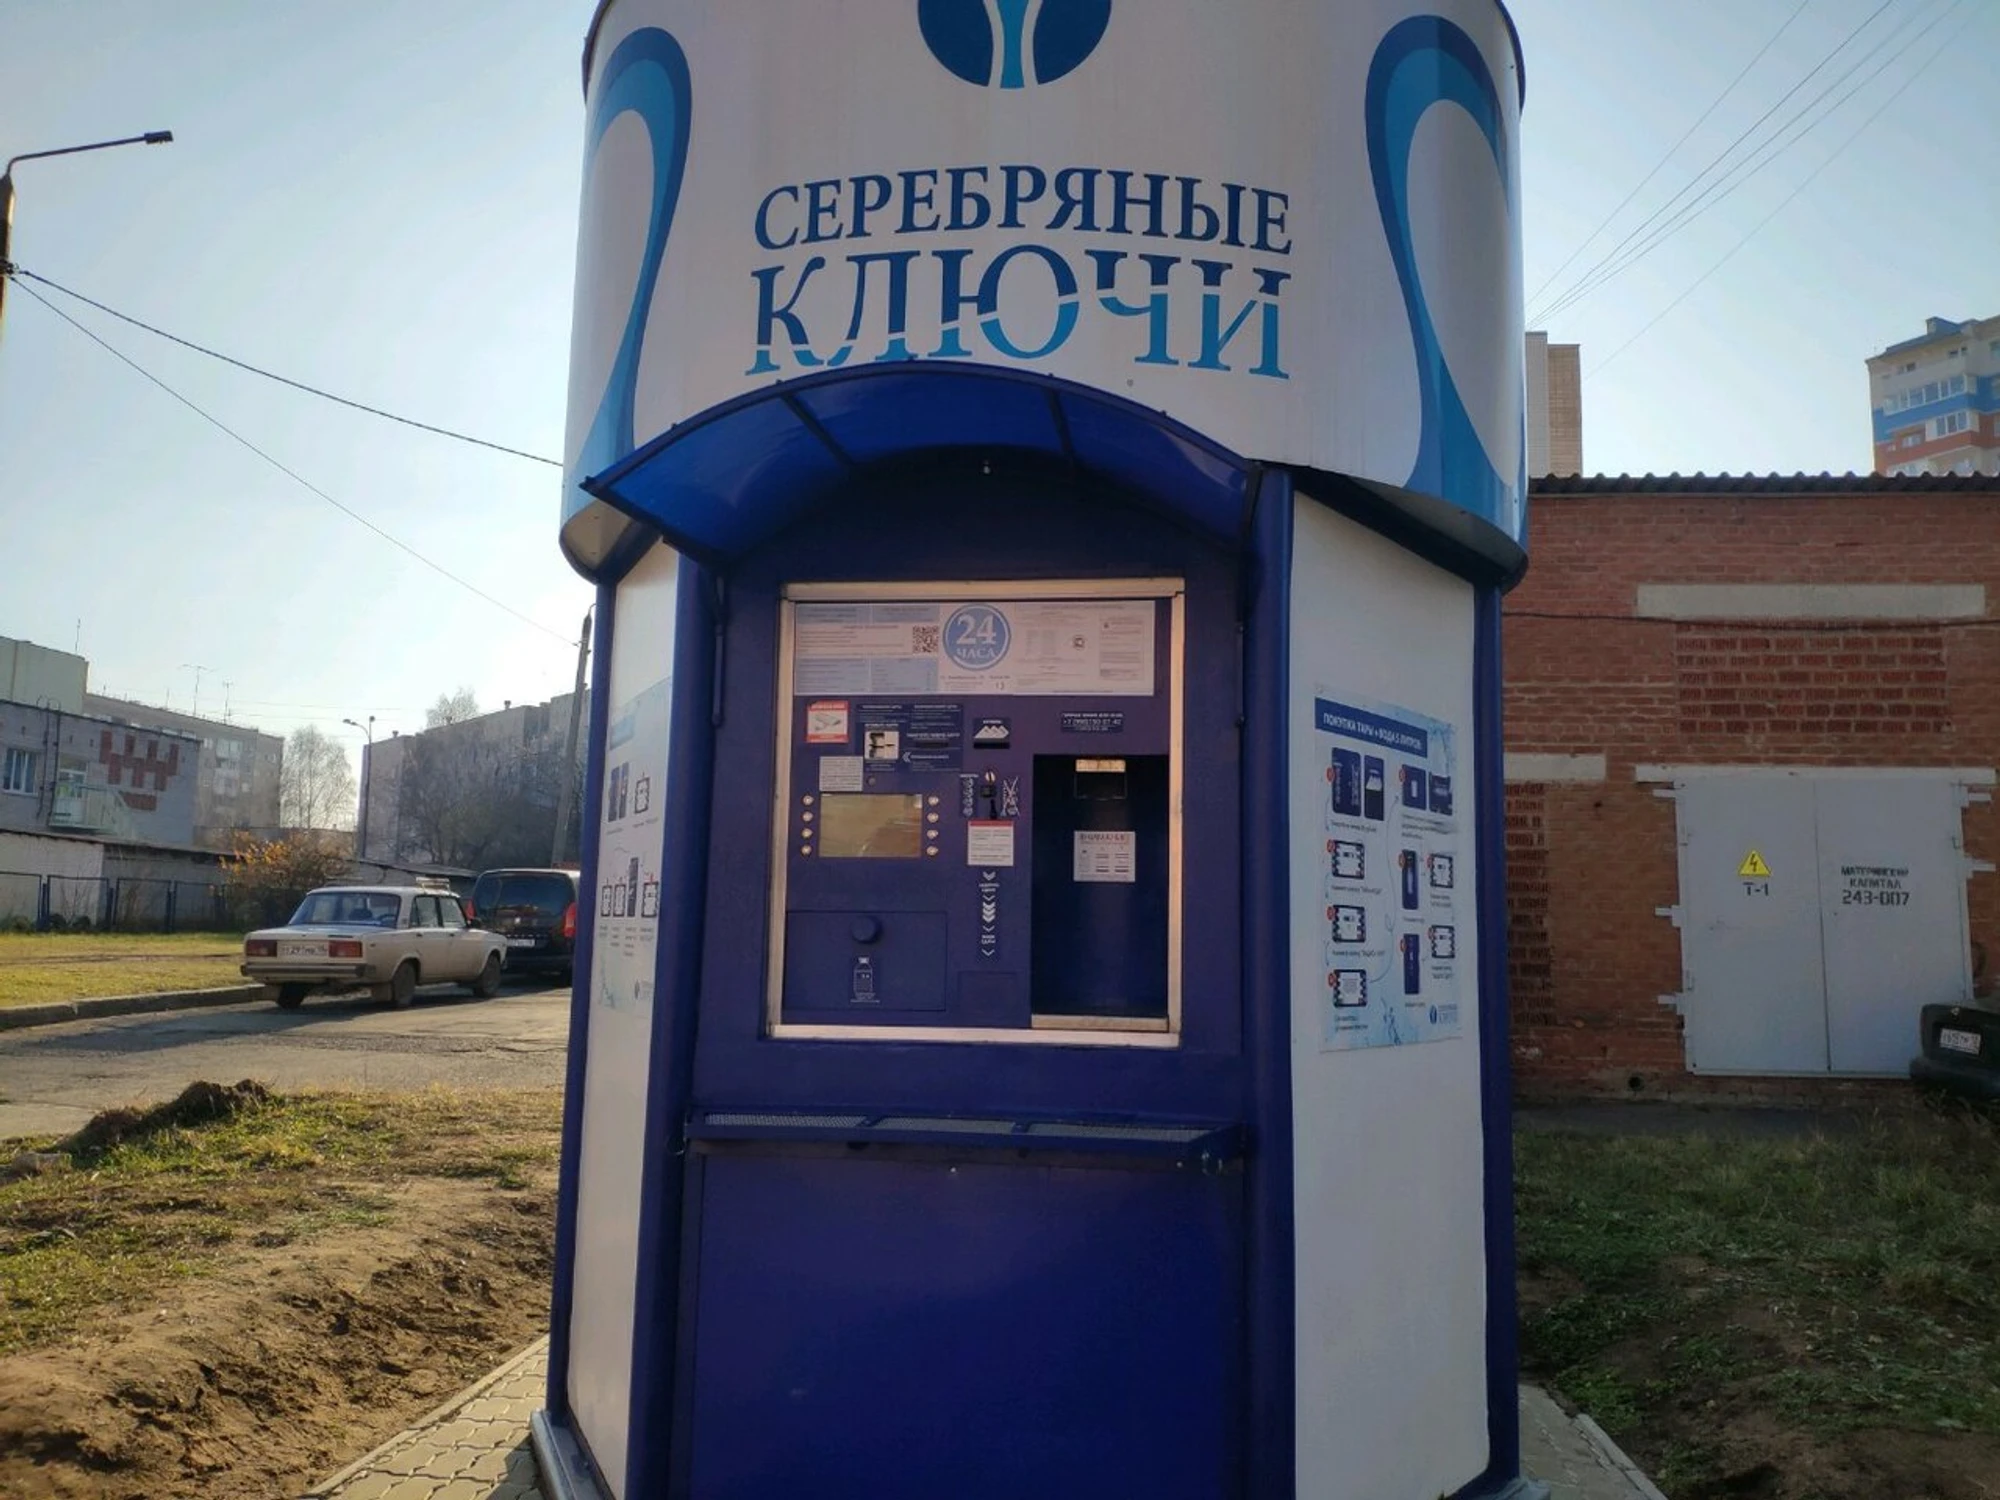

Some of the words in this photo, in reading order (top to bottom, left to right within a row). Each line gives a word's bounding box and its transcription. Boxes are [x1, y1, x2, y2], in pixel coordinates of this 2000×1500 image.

[754, 165, 1293, 255] СЕРЕБРЯНЫЕ
[745, 244, 1291, 379] КЛЮЧИ
[956, 613, 997, 645] 24
[956, 647, 997, 660] ЧАСА
[1323, 712, 1355, 730] ПОКУПКА
[1742, 881, 1770, 897] Т-1
[1842, 889, 1910, 906] 243-007
